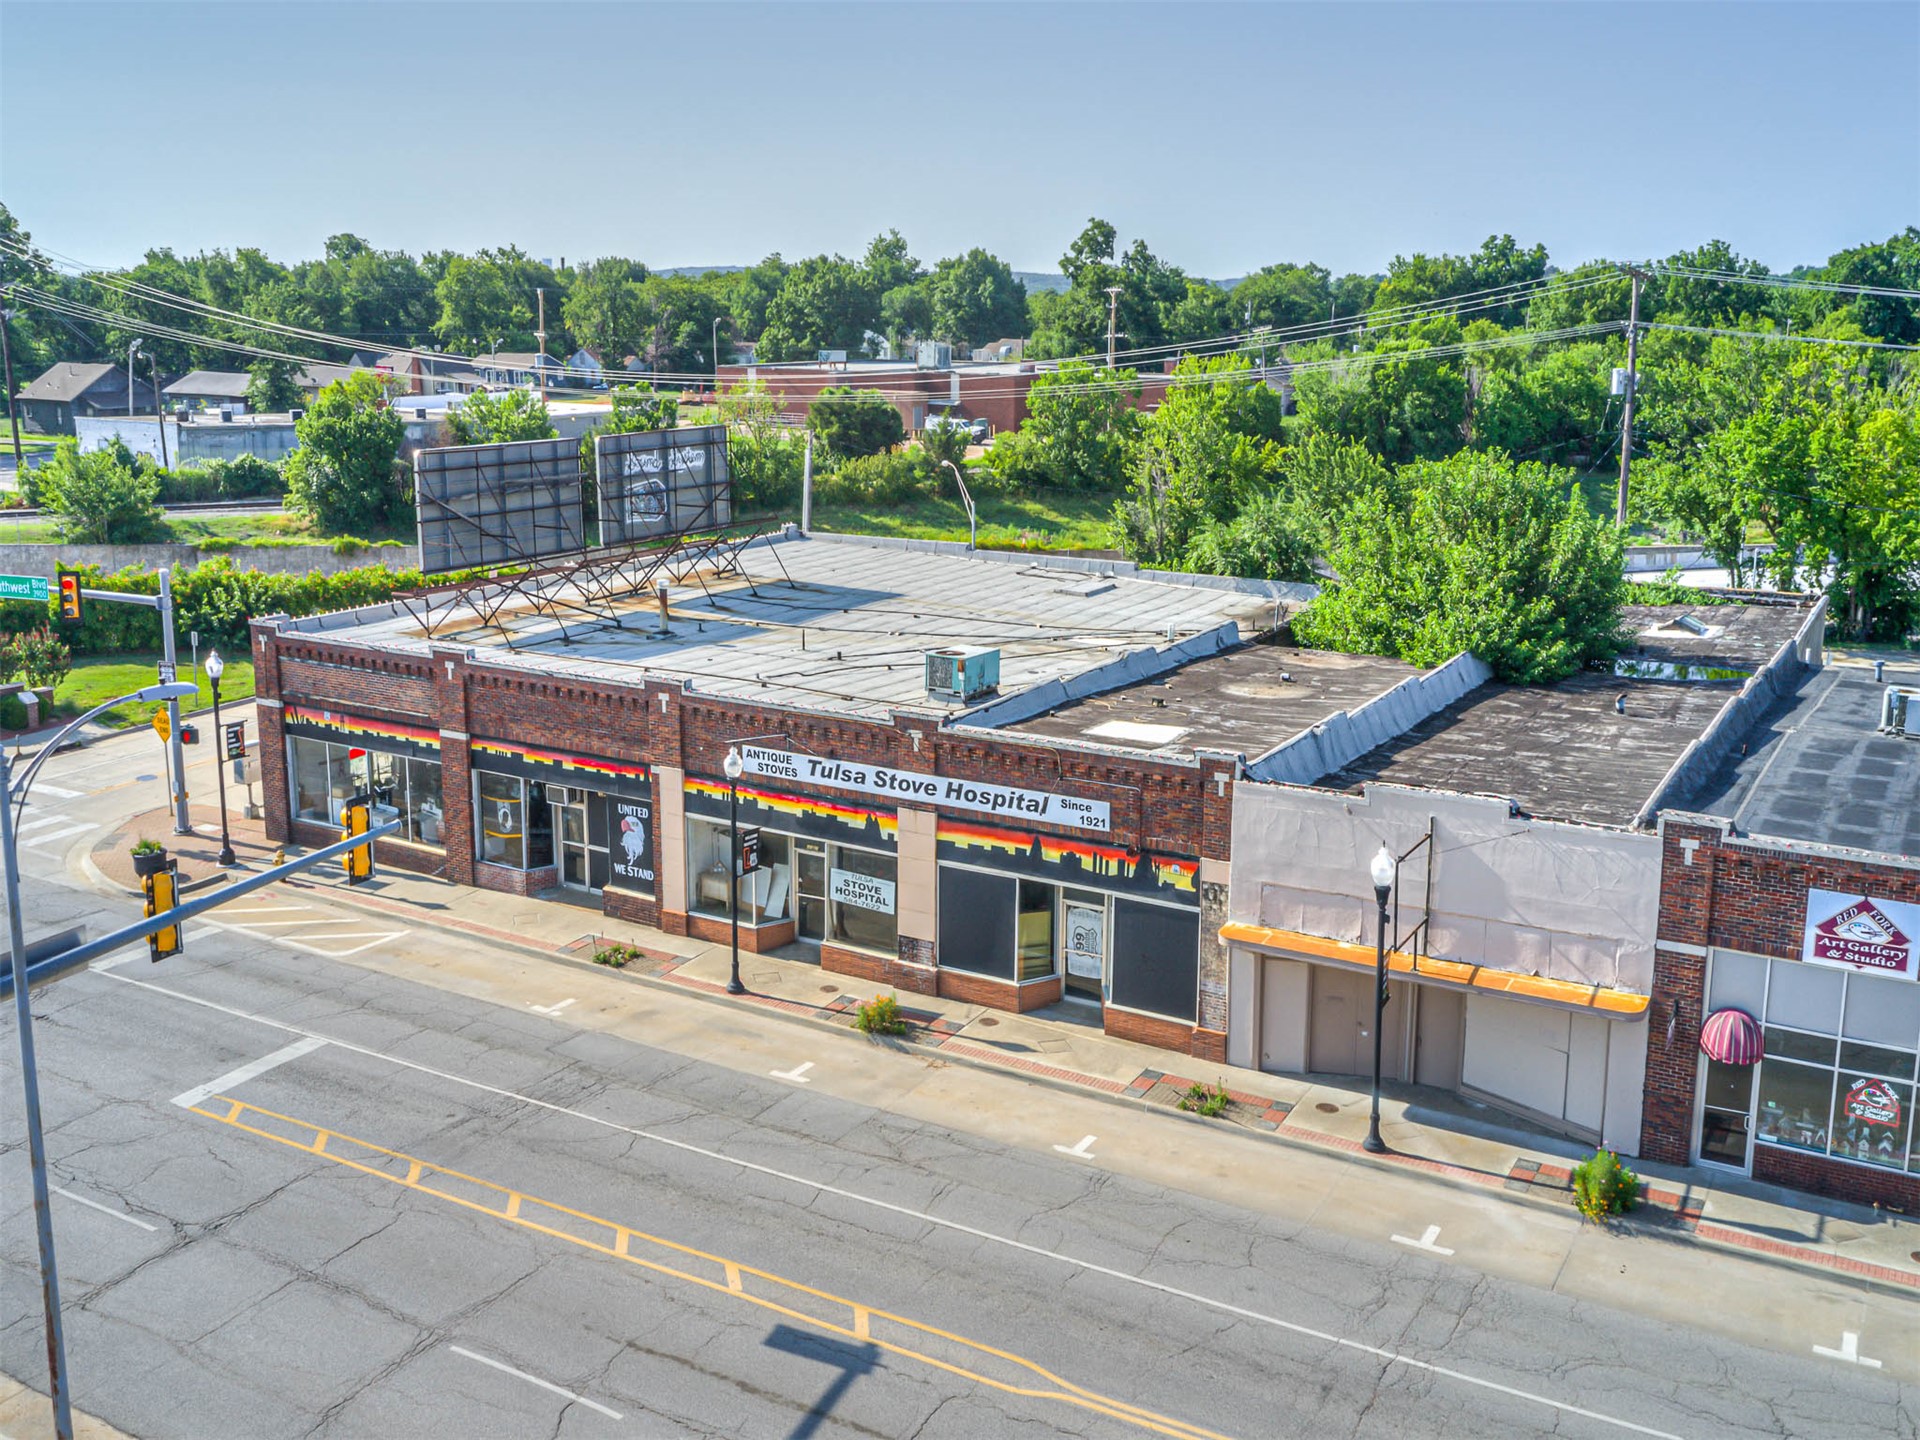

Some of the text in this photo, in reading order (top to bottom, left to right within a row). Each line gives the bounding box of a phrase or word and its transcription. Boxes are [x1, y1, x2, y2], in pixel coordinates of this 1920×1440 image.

[31, 579, 47, 589] Blvd
[746, 749, 792, 765] ANTIQUE
[757, 762, 798, 778] STOVES
[807, 758, 1049, 816] Tulsa Stove Hospital
[617, 803, 649, 819] UNITED
[1061, 799, 1092, 813] Since
[1079, 815, 1106, 829] 1921
[613, 862, 654, 881] WE STAND
[851, 873, 874, 884] TULSA
[843, 879, 882, 896] STOVE
[835, 886, 889, 907] HOSPITAL
[1835, 907, 1898, 936] RED FORK
[1075, 932, 1085, 951] 66
[1818, 938, 1906, 961] Art Gallery
[1826, 949, 1896, 968] & Studio
